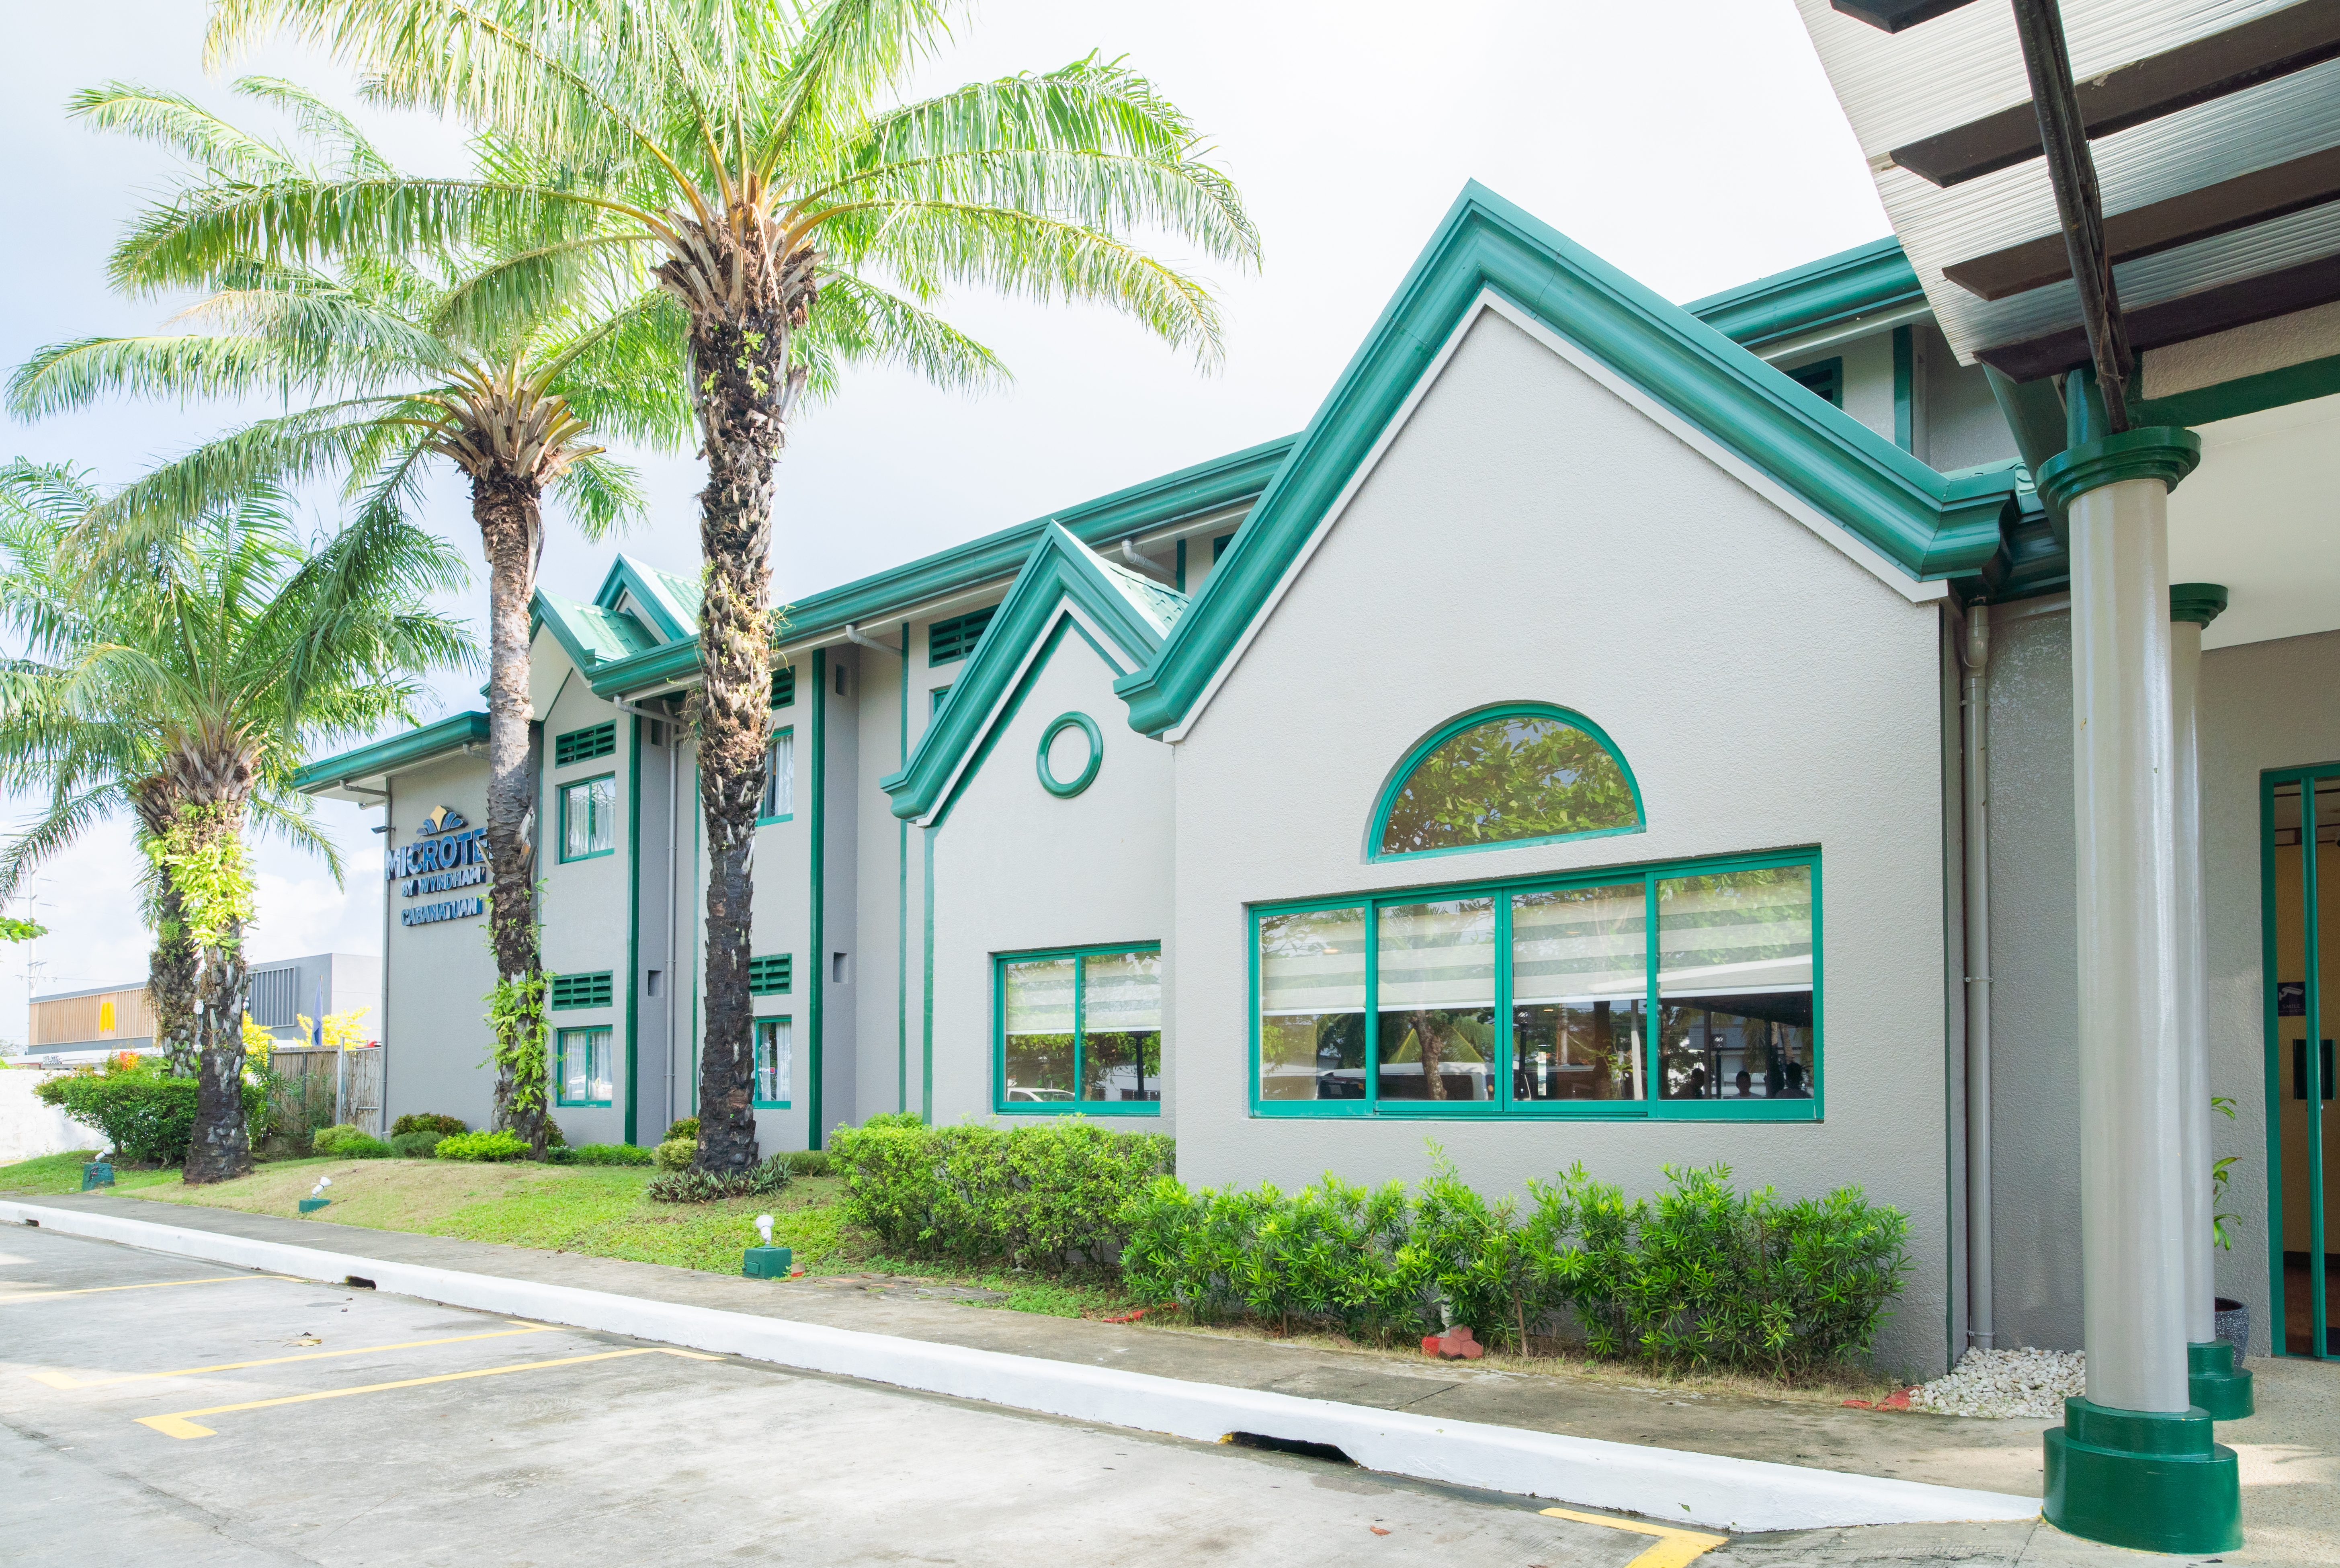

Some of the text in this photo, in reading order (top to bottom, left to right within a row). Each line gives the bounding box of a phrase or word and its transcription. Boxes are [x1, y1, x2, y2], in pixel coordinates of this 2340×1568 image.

[385, 827, 493, 880] MICROTE
[402, 866, 481, 897] BY WYNDHAM
[401, 896, 477, 926] CABANATUAN
